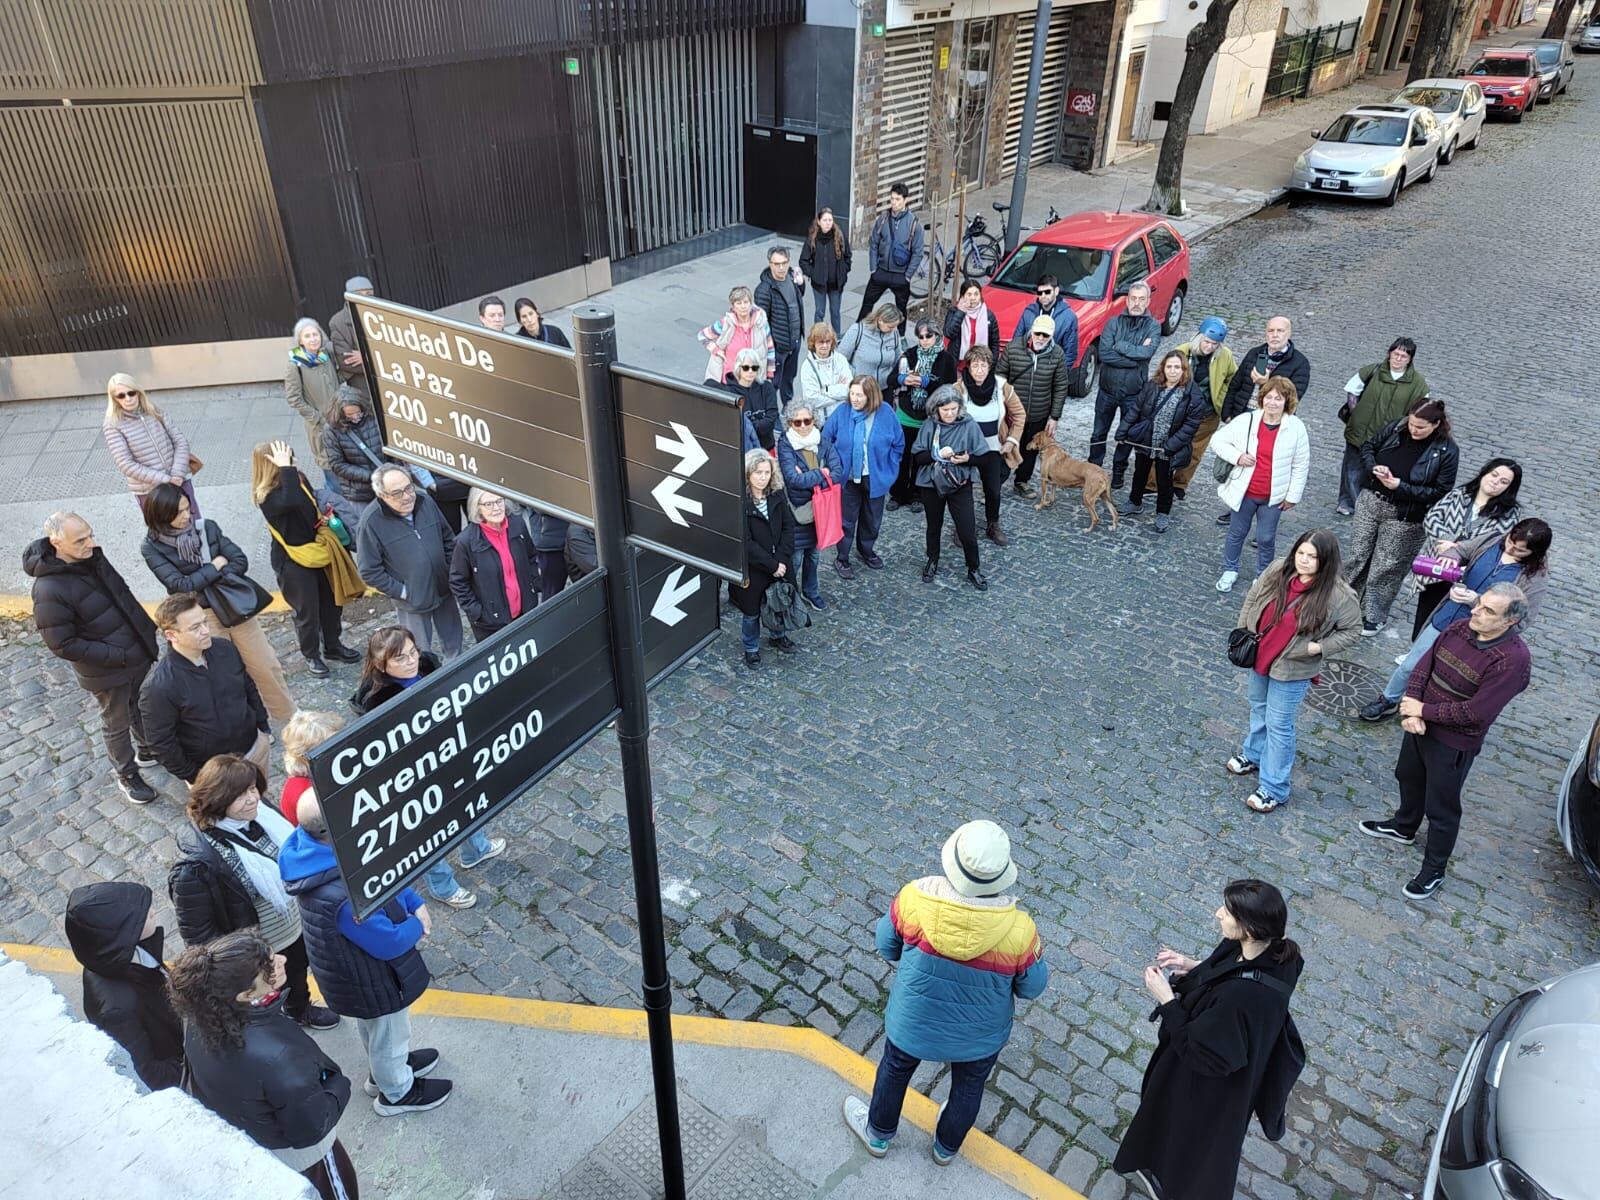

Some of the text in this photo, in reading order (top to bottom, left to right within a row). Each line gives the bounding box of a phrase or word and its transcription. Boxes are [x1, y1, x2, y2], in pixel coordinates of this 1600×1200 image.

[363, 311, 494, 373] Ciudad De
[374, 351, 457, 400] La Paz
[385, 391, 427, 427] 200
[449, 410, 491, 447] 100
[392, 430, 478, 474] Comuna 14
[330, 637, 538, 786] Concepción
[350, 722, 468, 828] Arenal
[357, 786, 444, 866] 2700
[472, 709, 544, 781] 2600
[363, 792, 490, 900] Comuna 14
